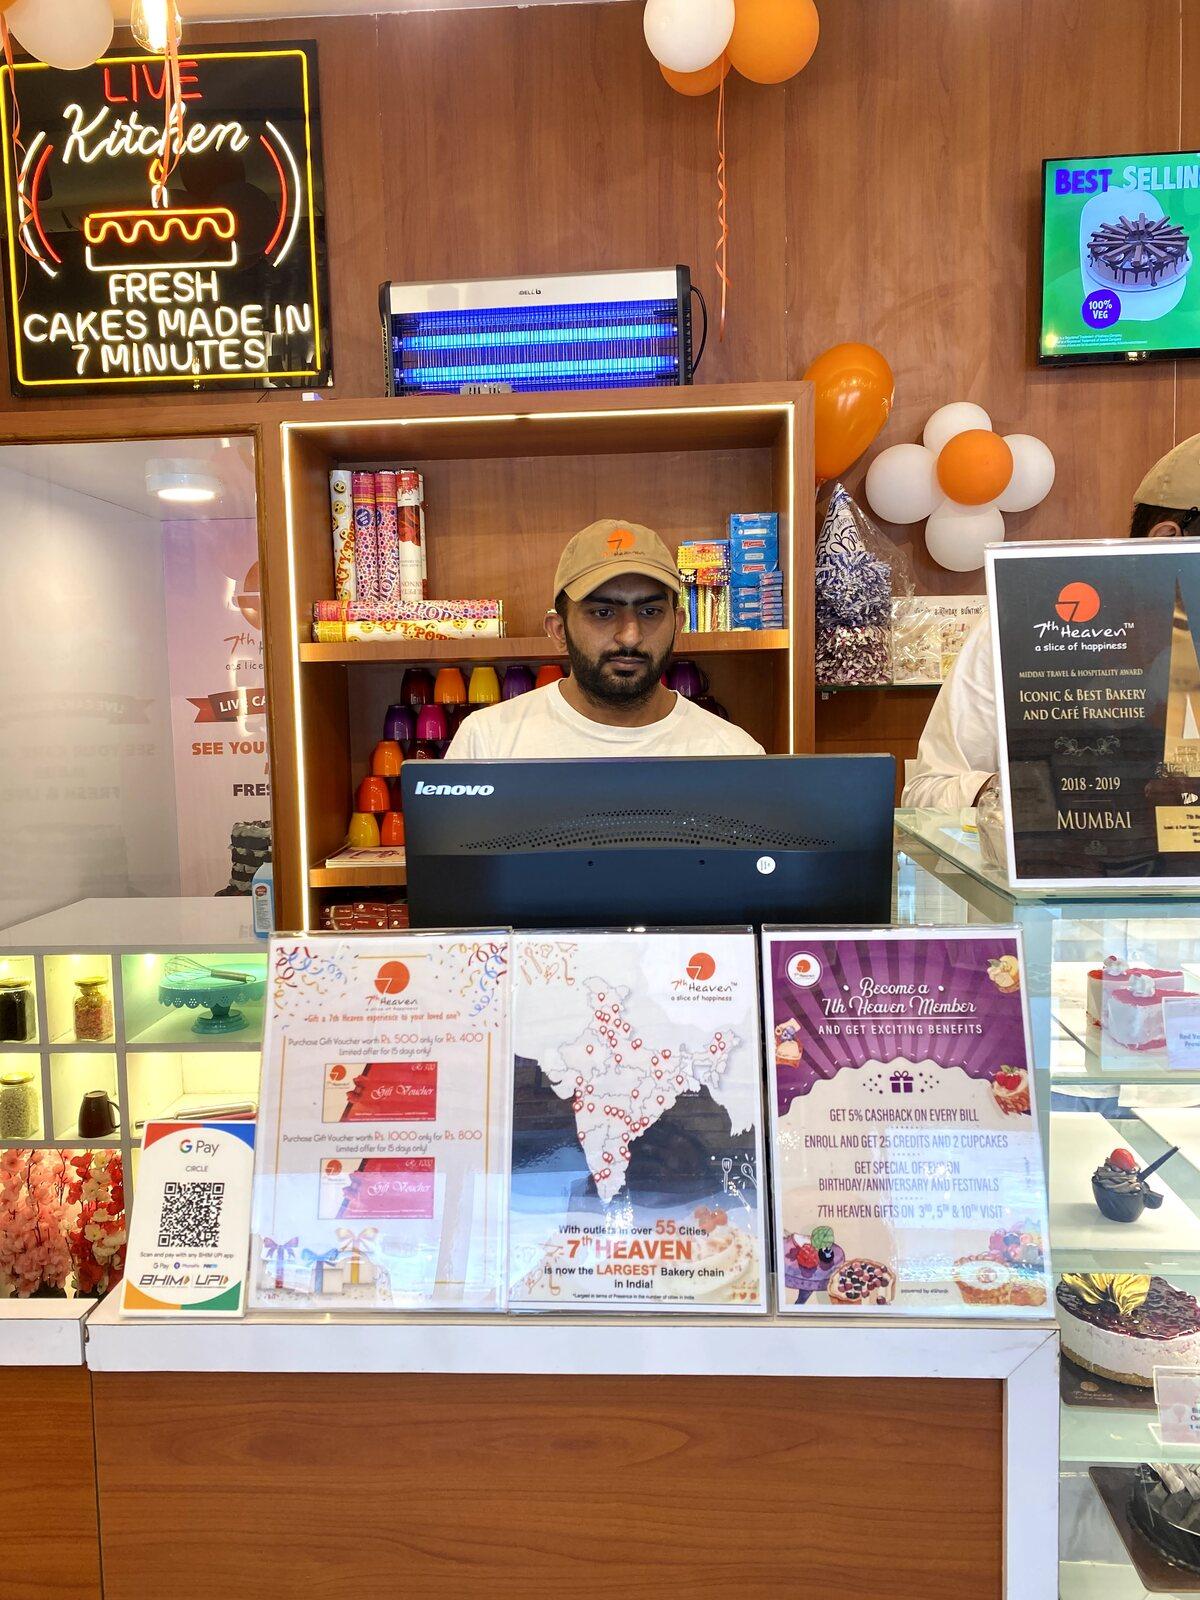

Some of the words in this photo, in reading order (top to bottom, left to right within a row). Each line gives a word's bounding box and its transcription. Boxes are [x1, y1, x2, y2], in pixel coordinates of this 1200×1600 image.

[104, 61, 202, 102] LIVE
[62, 101, 250, 164] Kitchen
[1056, 168, 1113, 195] BEST
[1123, 165, 1200, 191] SELLIN
[109, 270, 218, 305] FRESH
[1088, 300, 1113, 310] 100%
[1093, 309, 1109, 319] VEG
[23, 309, 148, 342] CAKES
[157, 305, 263, 339] MADE
[276, 303, 311, 336] IN
[71, 344, 90, 376] 7
[101, 339, 266, 374] MINUTES
[1033, 621, 1059, 639] 7th
[224, 633, 255, 655] 7th
[1043, 642, 1065, 651] slice
[1068, 642, 1079, 651] of
[1081, 641, 1127, 653] happiness
[1047, 670, 1070, 678] TRAVEL
[1070, 669, 1076, 677] &
[1077, 669, 1119, 677] HOSPITALITY
[1020, 690, 1061, 702] ICONIC
[1064, 689, 1073, 701] &
[1077, 689, 1102, 700] BEST
[1105, 689, 1146, 700] BAKERY
[220, 699, 248, 712] LIV
[1024, 710, 1048, 720] AND
[1052, 706, 1079, 719] CAFÉ
[1083, 707, 1145, 718] FRANCHISE
[192, 742, 223, 755] SEE
[229, 742, 267, 754] YOU
[414, 781, 495, 796] lenovo
[1061, 778, 1087, 790] 2018
[1096, 777, 1120, 790] 2019
[1057, 810, 1132, 829] MUMBAI
[860, 977, 915, 998] Become
[917, 985, 930, 994] a
[849, 996, 906, 1016] Heaven
[909, 995, 977, 1015] Member
[342, 1014, 363, 1022] Heaven
[367, 1014, 398, 1022] experience
[411, 1014, 424, 1022] your
[818, 1025, 841, 1035] AND
[846, 1024, 866, 1035] GET
[871, 1024, 923, 1035] EXCITING
[928, 1023, 983, 1035] BENEFITS
[289, 1038, 318, 1046] Purchase
[319, 1037, 332, 1045] Gift
[333, 1037, 361, 1045] Voucher
[394, 1034, 419, 1044] 500
[420, 1036, 434, 1045] only
[435, 1035, 444, 1043] for
[459, 1032, 484, 1042] 400
[339, 1048, 362, 1056] Limited
[363, 1048, 379, 1056] offer
[380, 1047, 390, 1055] for
[399, 1048, 415, 1057] days
[416, 1047, 431, 1055] only!
[396, 1084, 434, 1096] Voucher
[829, 1109, 847, 1122] GET
[849, 1109, 863, 1122] 5%
[865, 1109, 913, 1122] CASHBACK
[914, 1109, 927, 1121] ON
[930, 1109, 957, 1122] EVERY
[960, 1109, 979, 1121] BILL
[283, 1134, 313, 1143] Purchase
[314, 1133, 327, 1142] Gift
[328, 1134, 354, 1143] Voucher
[356, 1133, 373, 1142] worth
[388, 1131, 417, 1141] 1000
[418, 1132, 432, 1142] only
[433, 1132, 443, 1141] for
[458, 1130, 482, 1140] 800
[804, 1135, 839, 1148] ENROLL
[841, 1135, 859, 1148] AND
[861, 1135, 877, 1148] GET
[879, 1135, 891, 1148] 25
[893, 1135, 930, 1148] CREDITS
[932, 1135, 951, 1148] AND
[953, 1135, 959, 1148] 2
[961, 1135, 1009, 1148] CUPCAKES
[180, 1139, 193, 1153] G
[196, 1141, 219, 1157] Pay
[336, 1145, 358, 1153] Limited
[359, 1144, 376, 1153] offer
[377, 1144, 387, 1152] for
[396, 1144, 411, 1154] days
[412, 1143, 428, 1153] only!
[855, 1162, 871, 1174] GET
[873, 1162, 909, 1174] SPECIAL
[819, 1178, 928, 1191] BIRTHDAY/ANNIVERSARY
[931, 1178, 950, 1191] AND
[952, 1178, 999, 1191] FESTIVALS
[817, 1205, 834, 1218] 7TH
[837, 1205, 871, 1218] HEAVEN
[874, 1205, 899, 1218] GIFTS
[902, 1205, 915, 1218] ON
[952, 1205, 959, 1218] &
[981, 1206, 1003, 1218] VISIT
[559, 1225, 581, 1234] With
[631, 1227, 652, 1235] over
[655, 1220, 676, 1235] 55
[679, 1227, 710, 1238] Cities,
[567, 1235, 592, 1258] 7th
[595, 1240, 693, 1260] HEAVEN
[544, 1266, 552, 1274] is
[555, 1267, 575, 1275] now
[578, 1266, 593, 1275] the
[596, 1265, 657, 1276] LARGEST
[661, 1267, 694, 1278] Bakery
[697, 1268, 725, 1277] chain
[615, 1280, 623, 1288] in
[626, 1279, 653, 1289] India!
